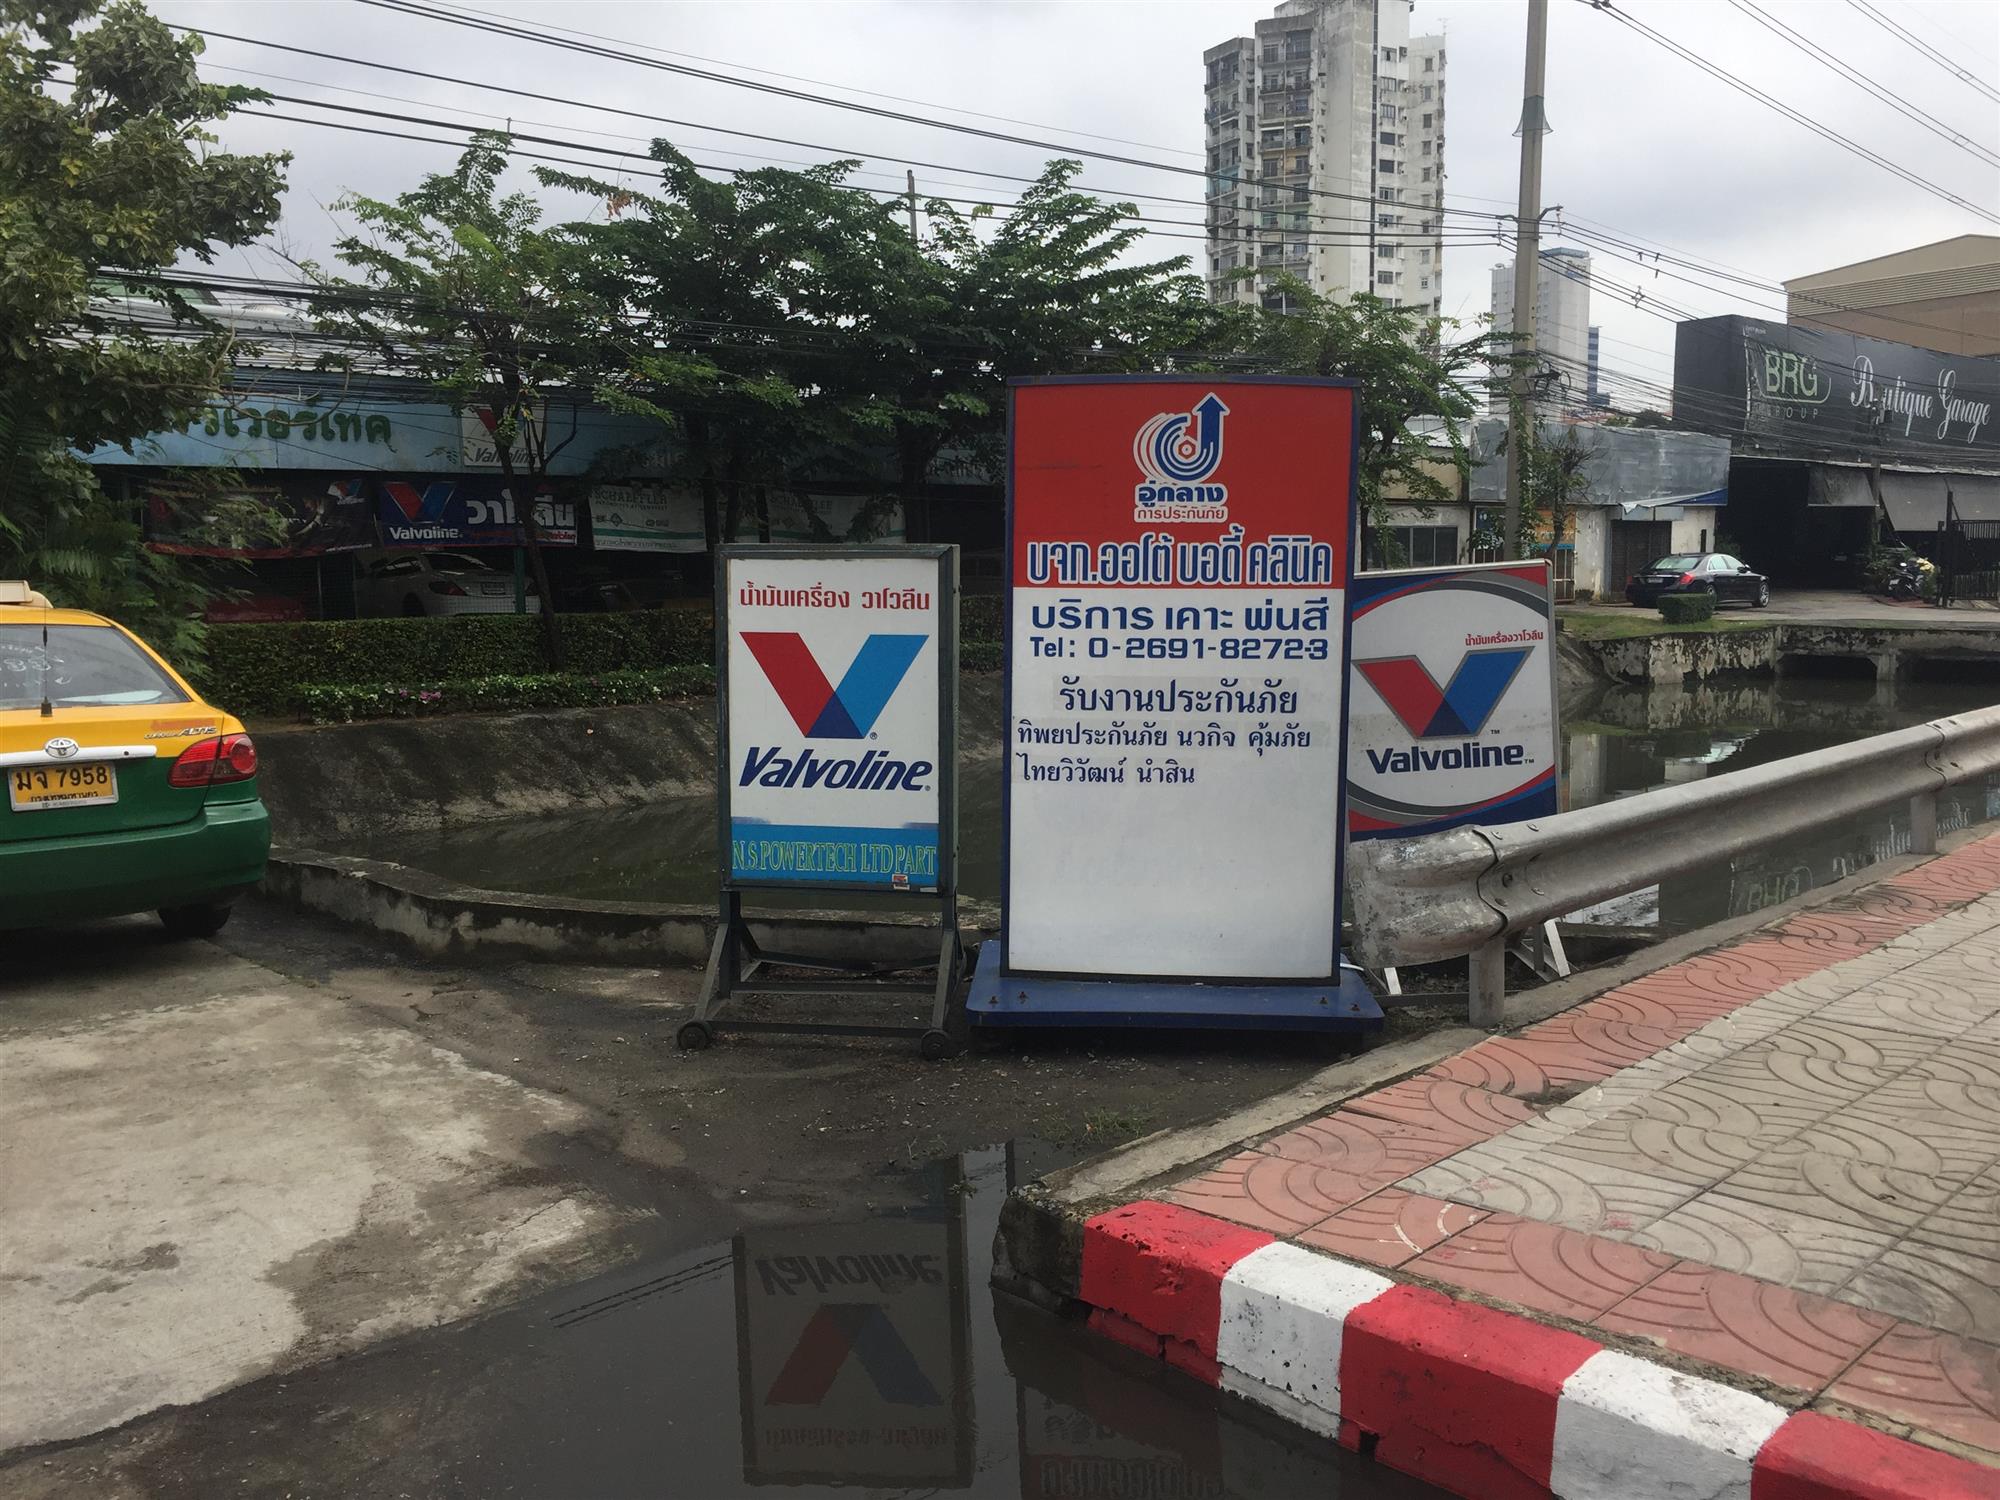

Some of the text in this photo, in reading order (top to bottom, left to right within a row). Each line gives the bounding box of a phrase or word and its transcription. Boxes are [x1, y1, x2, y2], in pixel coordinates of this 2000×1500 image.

[1766, 351, 1818, 397] BRG
[1850, 355, 1992, 444] Butique Garage
[465, 488, 576, 527] วาโลีน
[1138, 480, 1225, 507] อู่กลาง
[1137, 505, 1225, 520] การประกันภัย
[389, 526, 460, 540] Valvoline
[1029, 525, 1332, 584] บจก.ออโต้ บอดี้ คลินิค
[740, 581, 930, 610] น้ำมันเครื่อง วาโวลีน
[1031, 596, 1329, 631] บริการ เคาะ พ่นสี
[1029, 636, 1076, 658] Tel:
[1059, 675, 1298, 713] รับงานประกันภัย
[177, 725, 218, 737] ALTIS
[1017, 719, 1311, 757] ทิพยประกันภัย นวกิจ คุ้มภัย
[739, 747, 933, 791] Valvoline
[1015, 752, 1196, 784] ไทยวิวัฒน์ นำสิน
[1366, 742, 1525, 775] Valvoline
[16, 766, 108, 791] มจ 7958
